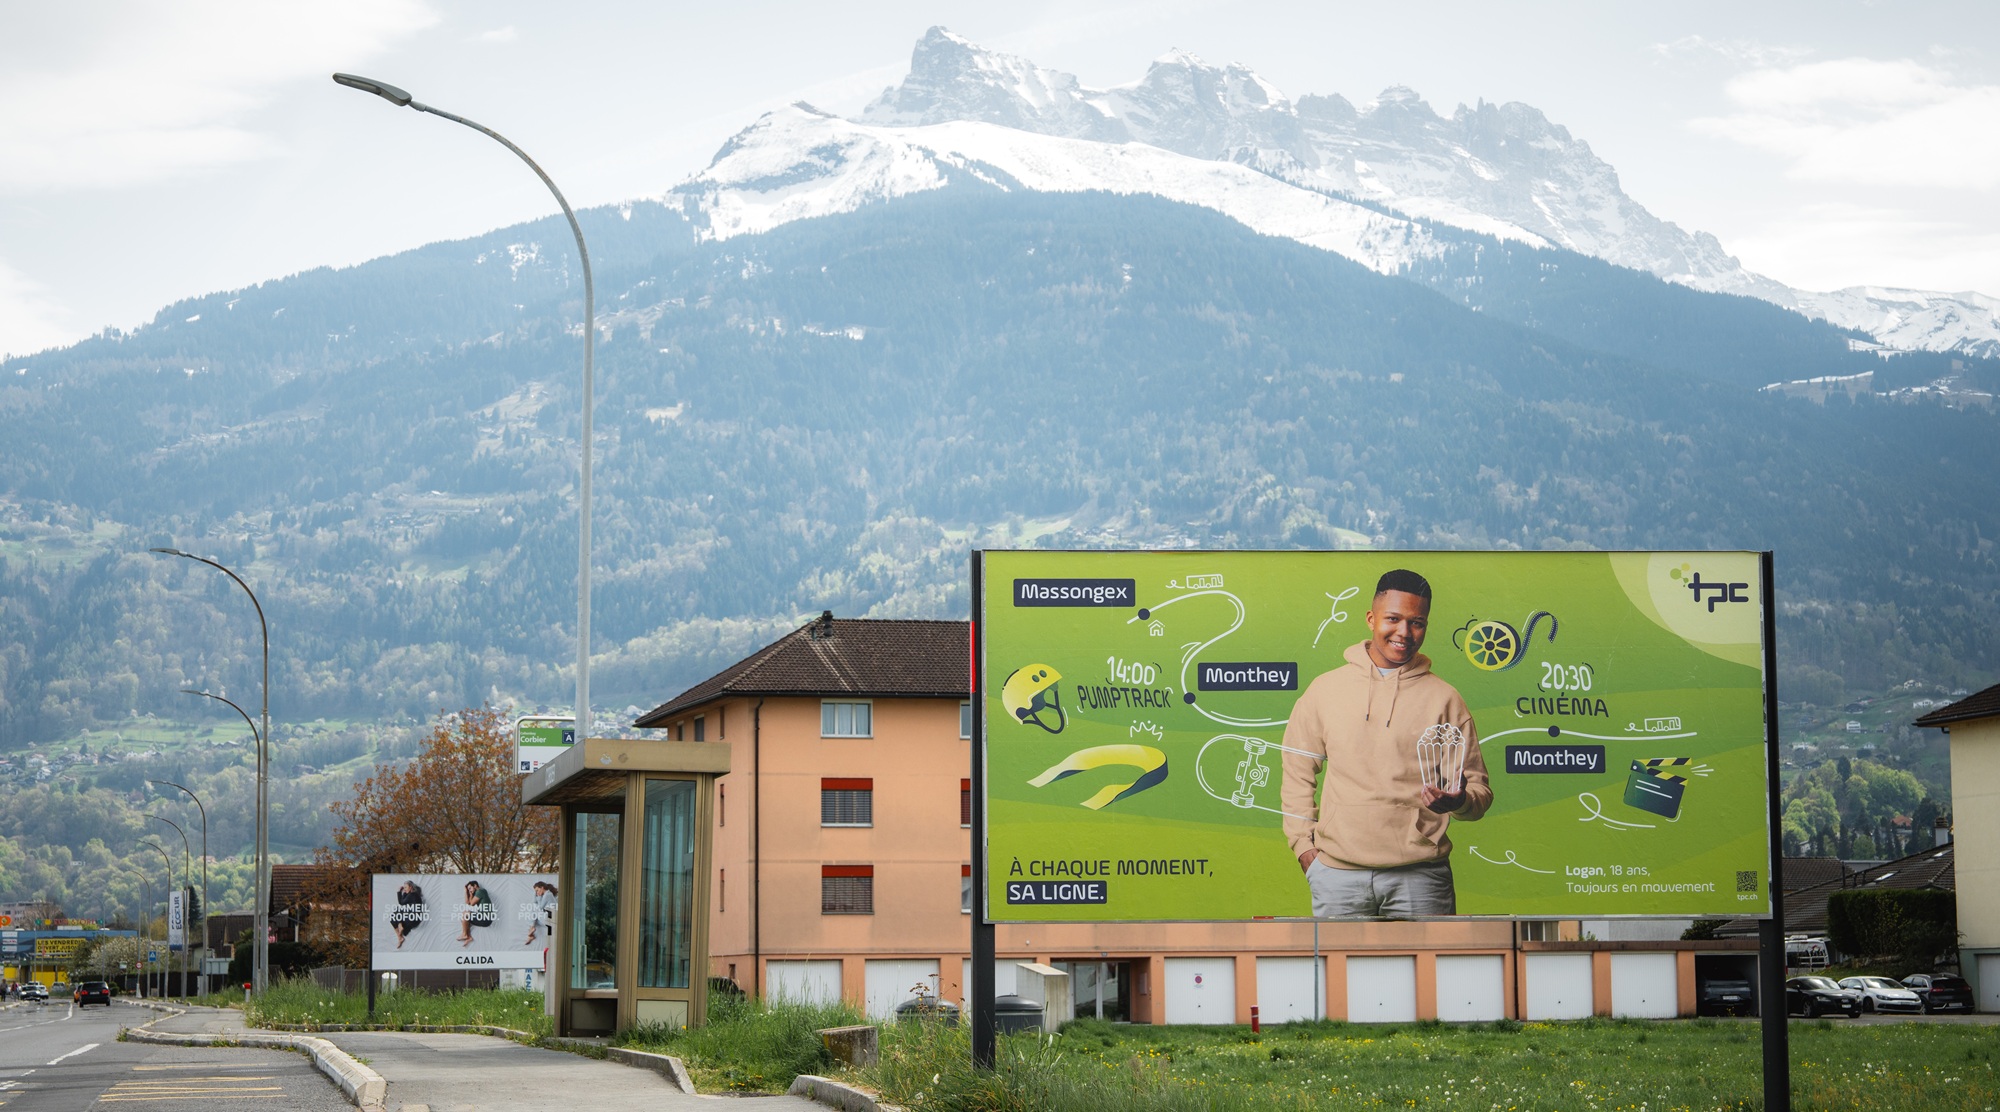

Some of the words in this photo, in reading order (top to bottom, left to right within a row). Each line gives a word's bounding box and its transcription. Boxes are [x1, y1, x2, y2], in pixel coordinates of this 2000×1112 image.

[1020, 583, 1128, 603] Massongex
[1687, 572, 1749, 613] tpc
[1106, 656, 1155, 686] 14:00
[1205, 668, 1291, 687] Monthey
[1541, 661, 1592, 692] 20:30
[1077, 686, 1171, 710] PUMPTRACK
[1516, 691, 1609, 718] CINÉMA
[1513, 750, 1599, 769] Monthey
[1009, 855, 1025, 877] À
[1029, 860, 1111, 879] CHAQUE
[1116, 858, 1214, 878] MOMENT,
[1565, 864, 1607, 878] Logan,
[1610, 864, 1622, 877] 18
[1626, 864, 1651, 877] ans,
[1009, 884, 1037, 901] SA
[1041, 883, 1105, 901] LIGNE.
[1566, 881, 1618, 895] Toujours
[1621, 884, 1638, 893] en
[1640, 881, 1716, 893] mouvement
[382, 912, 432, 922] PROFOND.
[384, 903, 430, 913] SOMMEIL
[451, 912, 500, 922] PROFOND.
[452, 903, 498, 913] SOMMEIL
[456, 956, 494, 965] CALIDA
